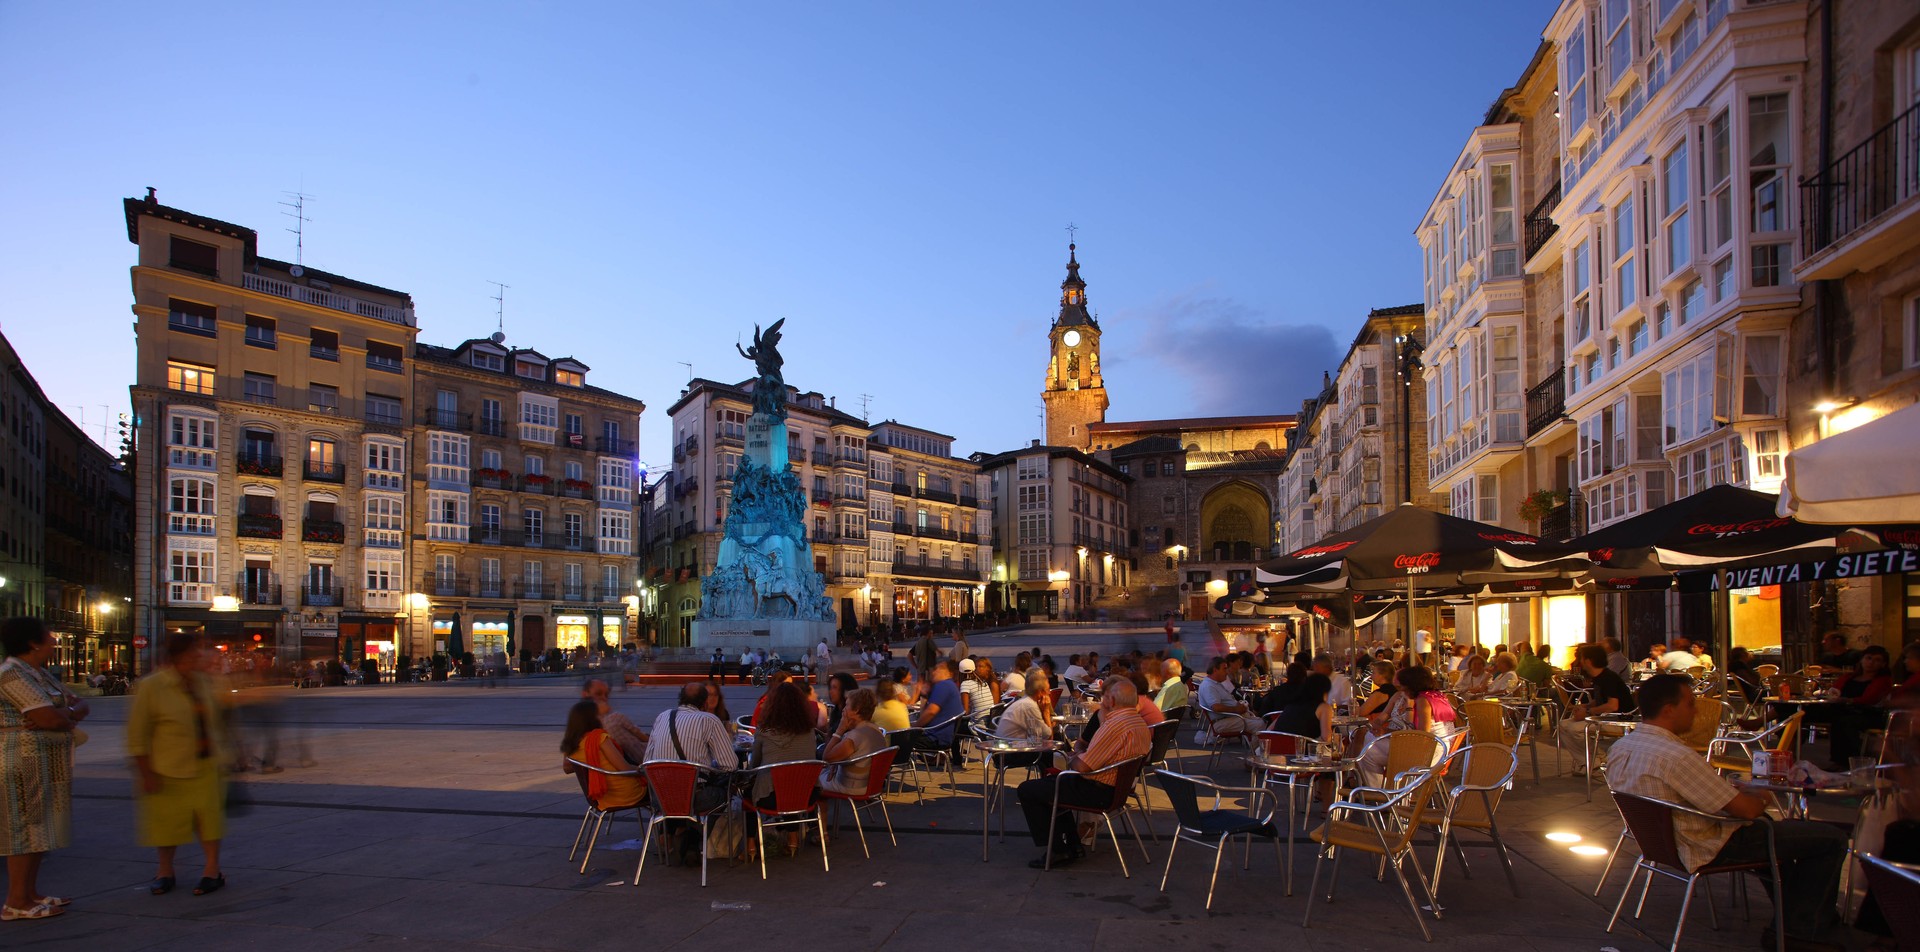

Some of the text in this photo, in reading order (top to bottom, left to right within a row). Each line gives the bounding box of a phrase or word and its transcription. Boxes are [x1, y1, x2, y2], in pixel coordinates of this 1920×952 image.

[1394, 552, 1441, 569] Coca-Cola
[1407, 565, 1429, 574] zero
[1710, 550, 1917, 590] NOVENTA Y SIETE
